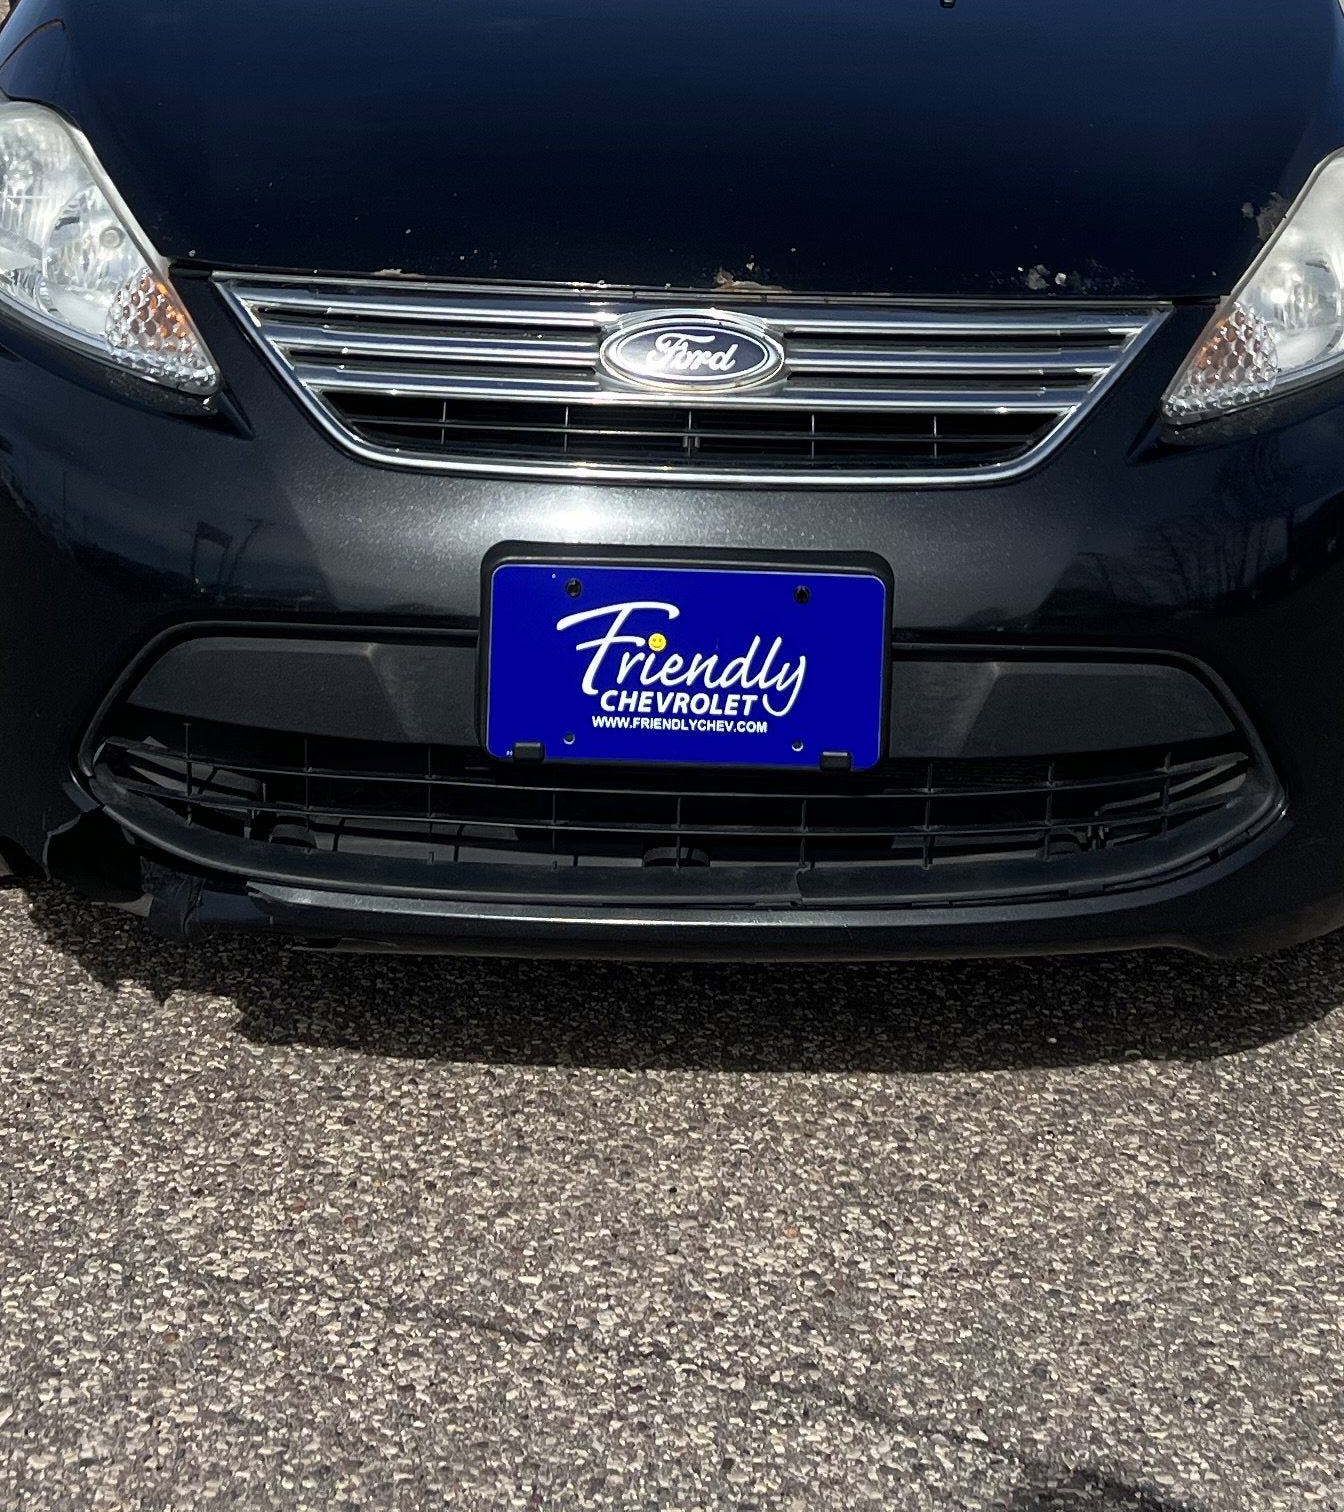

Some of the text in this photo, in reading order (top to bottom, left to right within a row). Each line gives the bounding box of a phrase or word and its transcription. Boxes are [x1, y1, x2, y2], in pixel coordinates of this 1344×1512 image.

[646, 332, 739, 371] Ford
[556, 601, 807, 717] Friendly
[600, 689, 759, 716] CHEVROLET
[591, 715, 768, 734] WWW.FRIENDLYCHEV.COM
